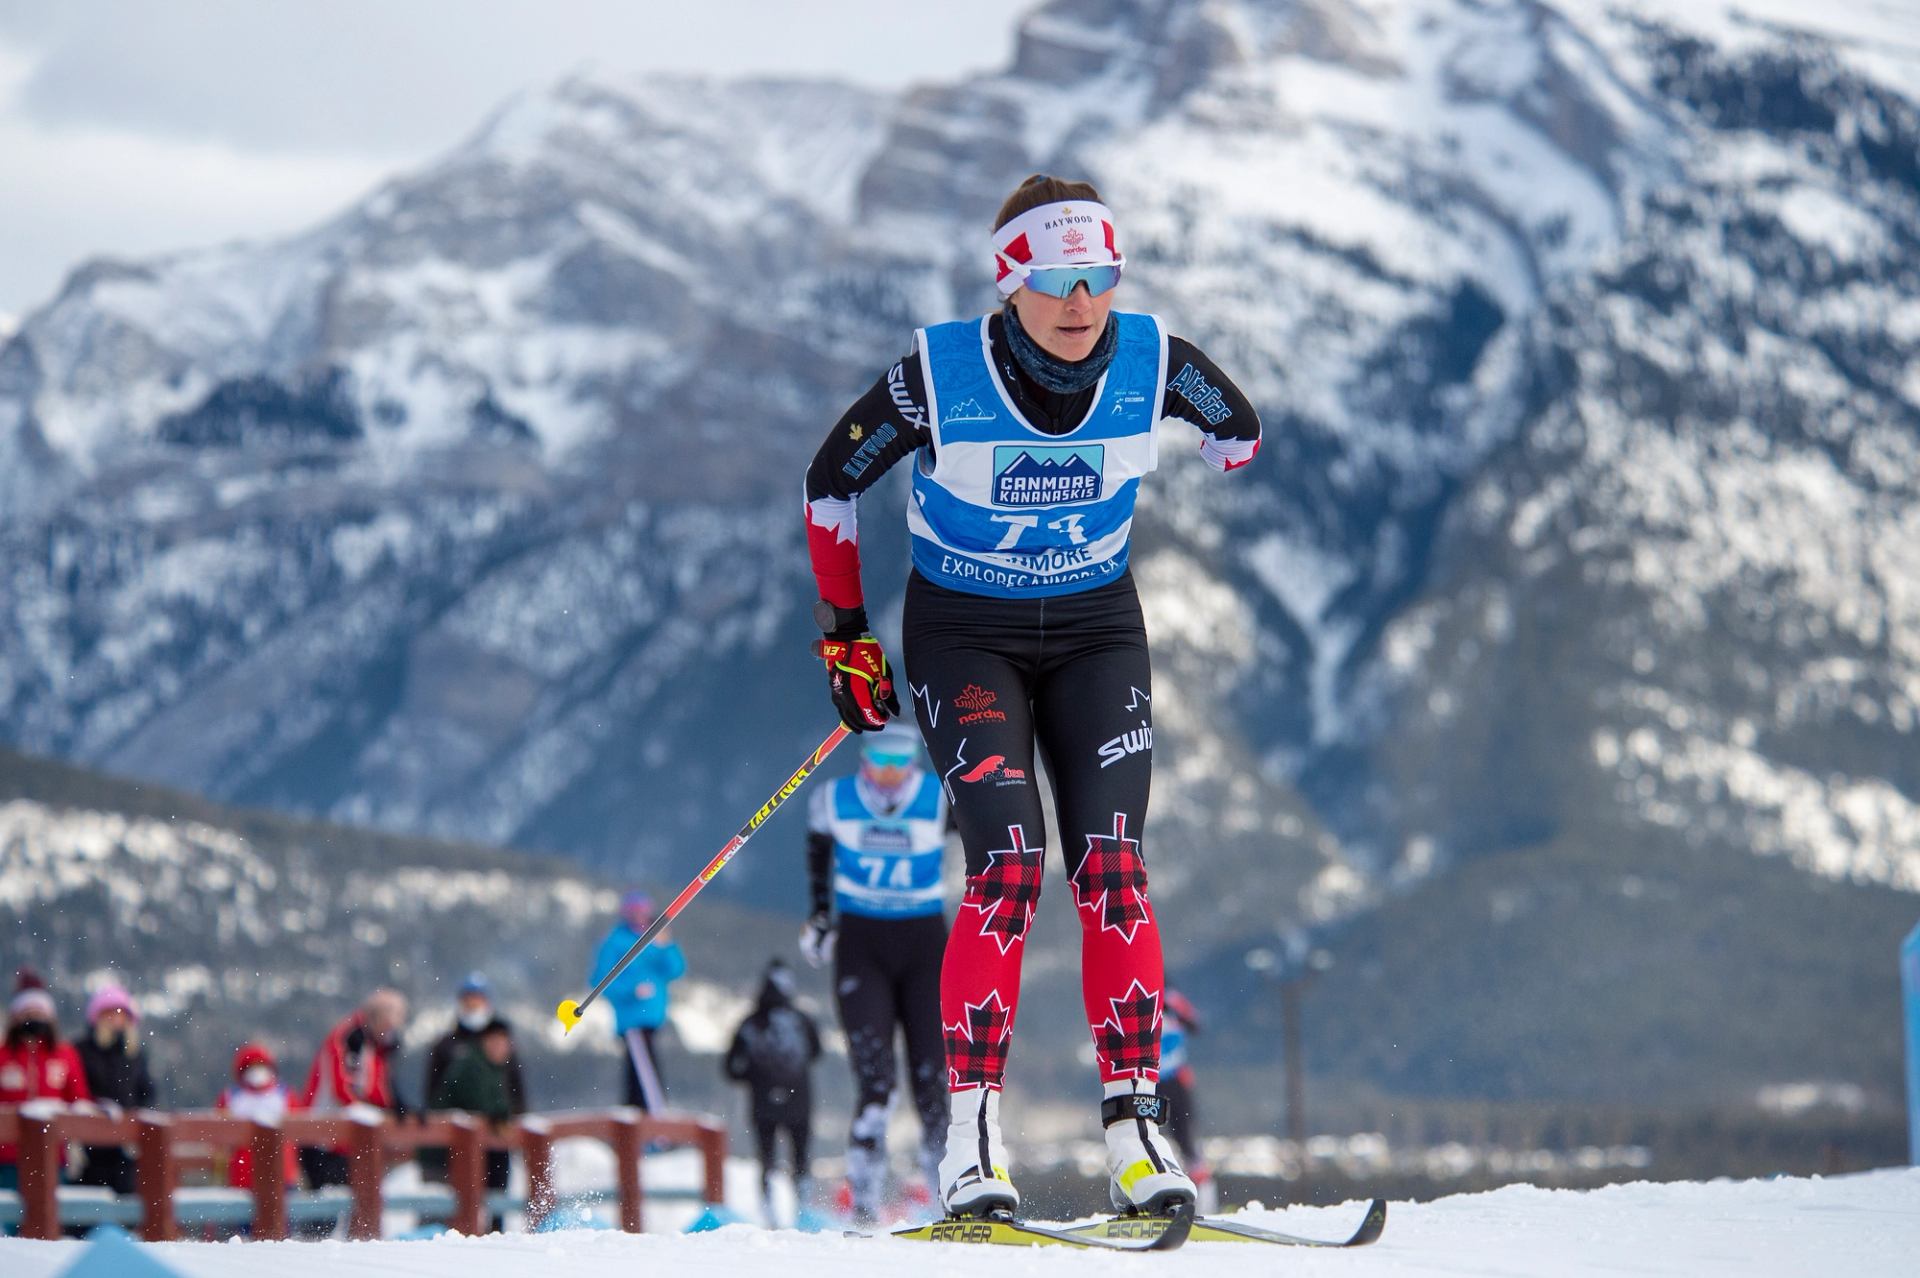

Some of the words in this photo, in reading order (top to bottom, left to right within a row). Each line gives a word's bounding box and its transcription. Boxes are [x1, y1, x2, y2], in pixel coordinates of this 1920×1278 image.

[1045, 215, 1092, 230] HAYWOOD
[842, 423, 897, 479] HAYWOOD
[1001, 475, 1095, 491] CANMORE
[1000, 488, 1094, 503] KANANASKIS
[959, 709, 1006, 725] nordiq
[859, 857, 912, 889] 74
[930, 1225, 992, 1243] FISCHER
